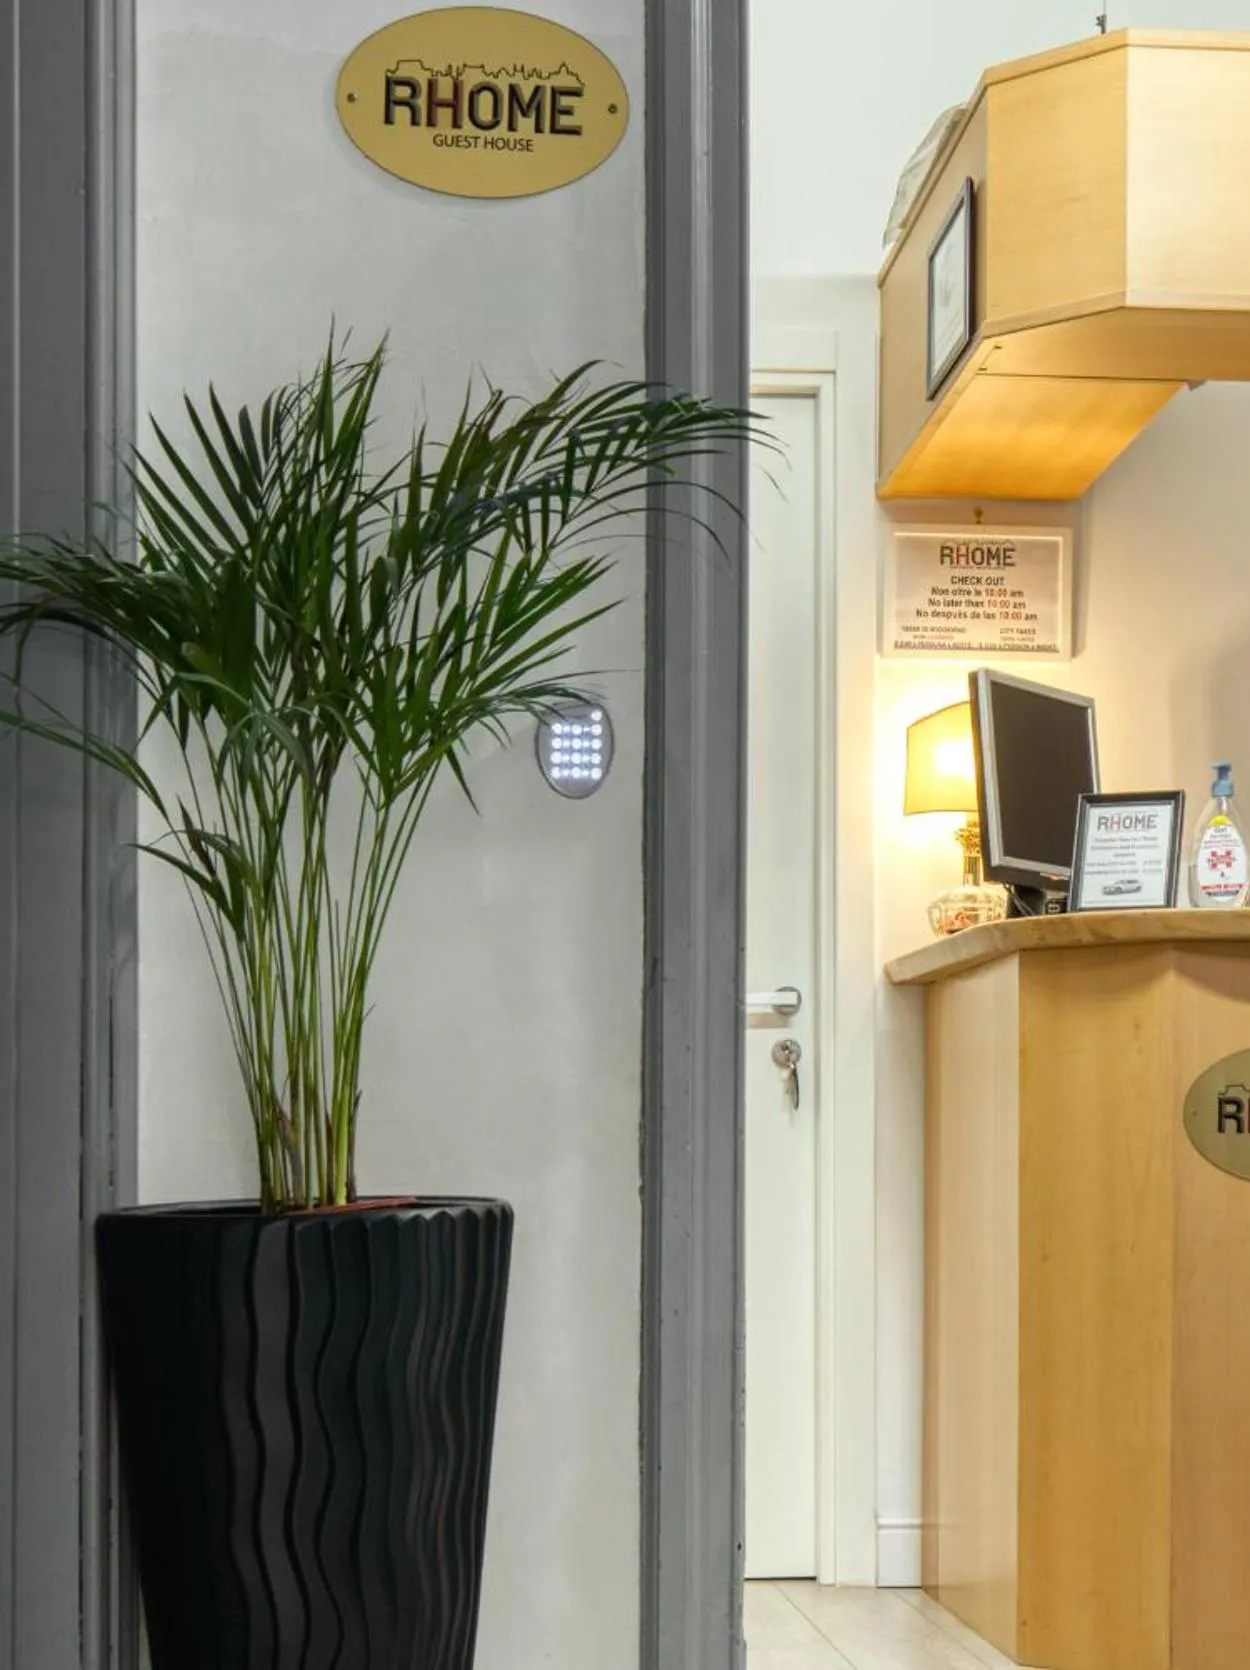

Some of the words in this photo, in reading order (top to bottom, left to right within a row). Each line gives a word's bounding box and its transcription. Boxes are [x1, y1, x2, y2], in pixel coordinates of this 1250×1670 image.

[383, 75, 585, 136] RHOME
[432, 133, 481, 149] GUEST
[483, 135, 534, 153] HOUSE
[938, 545, 1017, 568] RHOME
[950, 576, 984, 586] CHECK
[985, 576, 1005, 586] OUT
[930, 586, 950, 597] Non
[927, 598, 941, 607] No
[942, 598, 963, 608] later
[1012, 600, 1026, 609] am
[916, 608, 930, 619] No
[970, 610, 982, 620] de
[1024, 612, 1038, 621] am
[1096, 813, 1159, 831] RHOME
